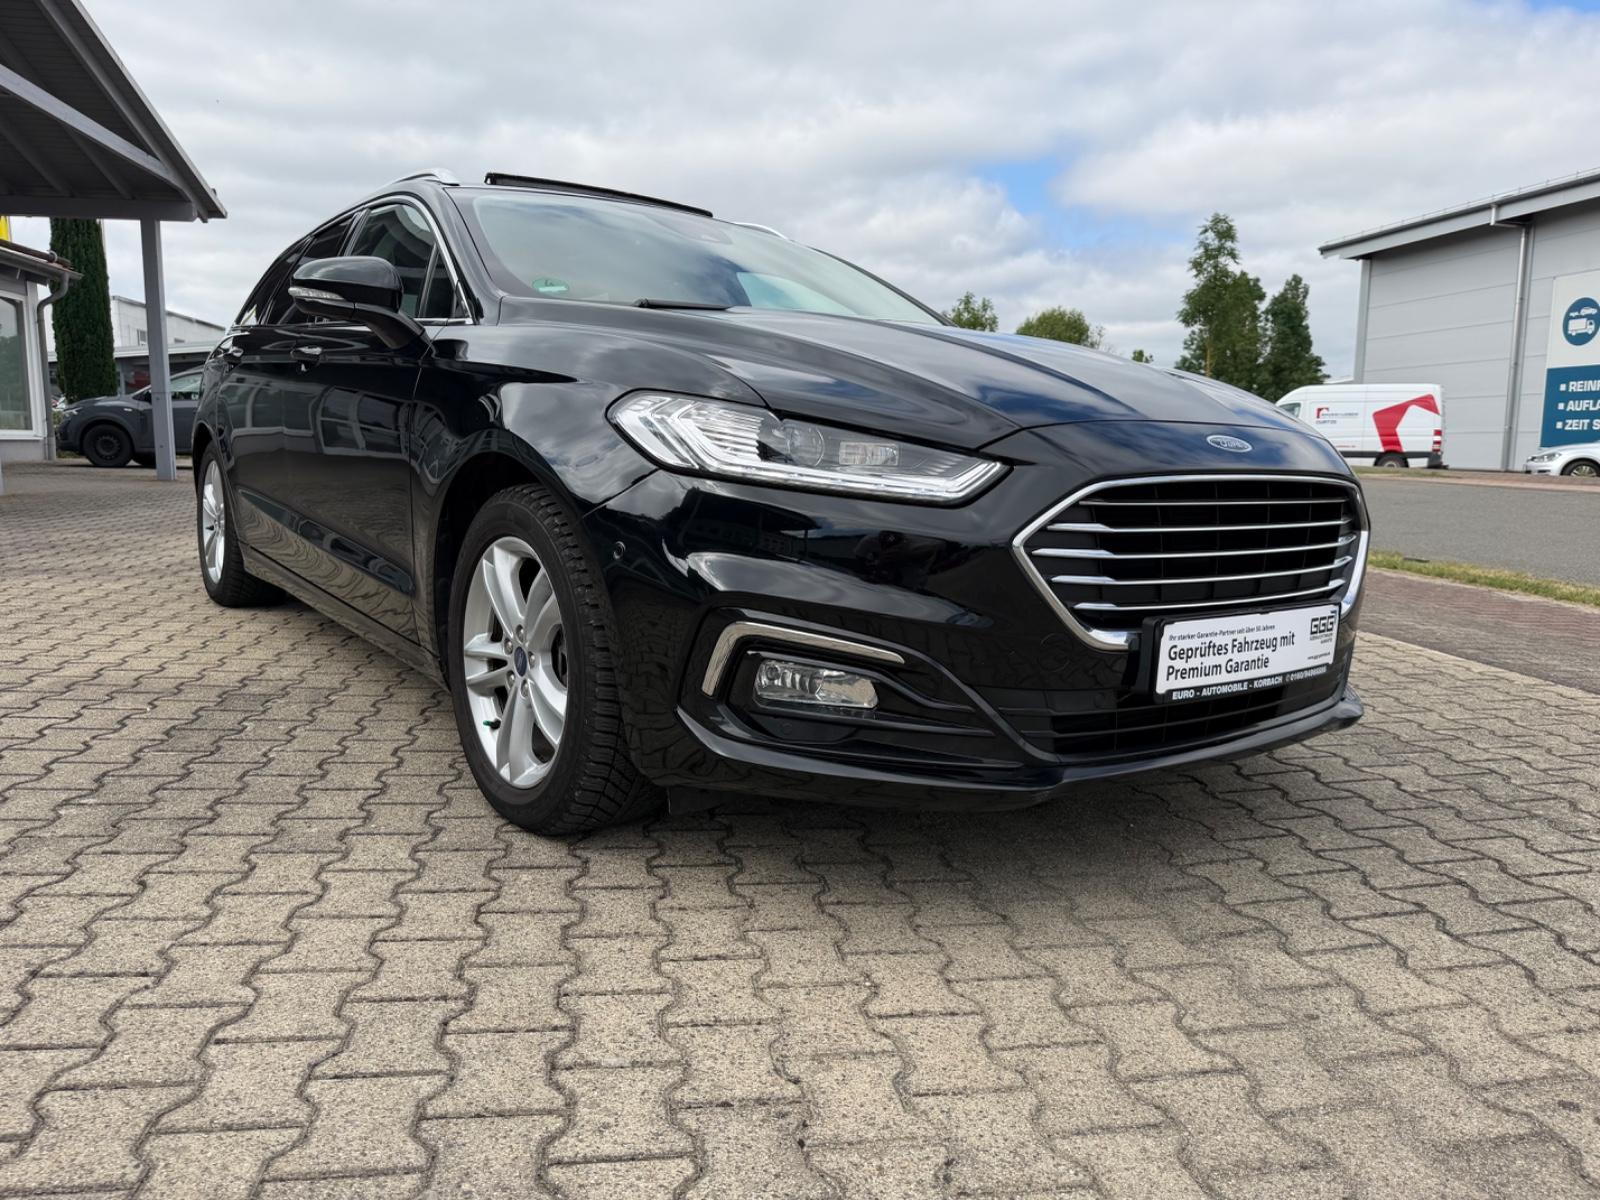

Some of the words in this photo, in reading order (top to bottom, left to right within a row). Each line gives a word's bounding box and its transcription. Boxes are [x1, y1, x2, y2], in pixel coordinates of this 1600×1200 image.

[1564, 419, 1590, 430] ZEIT
[1310, 615, 1335, 635] GGG
[1168, 640, 1229, 663] Geprüftes
[1231, 636, 1278, 654] Fahrzeug
[1280, 631, 1295, 647] mit
[1178, 633, 1196, 641] starker
[1166, 662, 1222, 681] Premium
[1225, 653, 1270, 674] Garantie
[1172, 689, 1195, 700] EURO
[1201, 681, 1249, 697] AUTOMOBILE
[1253, 675, 1283, 689] KORBACH
